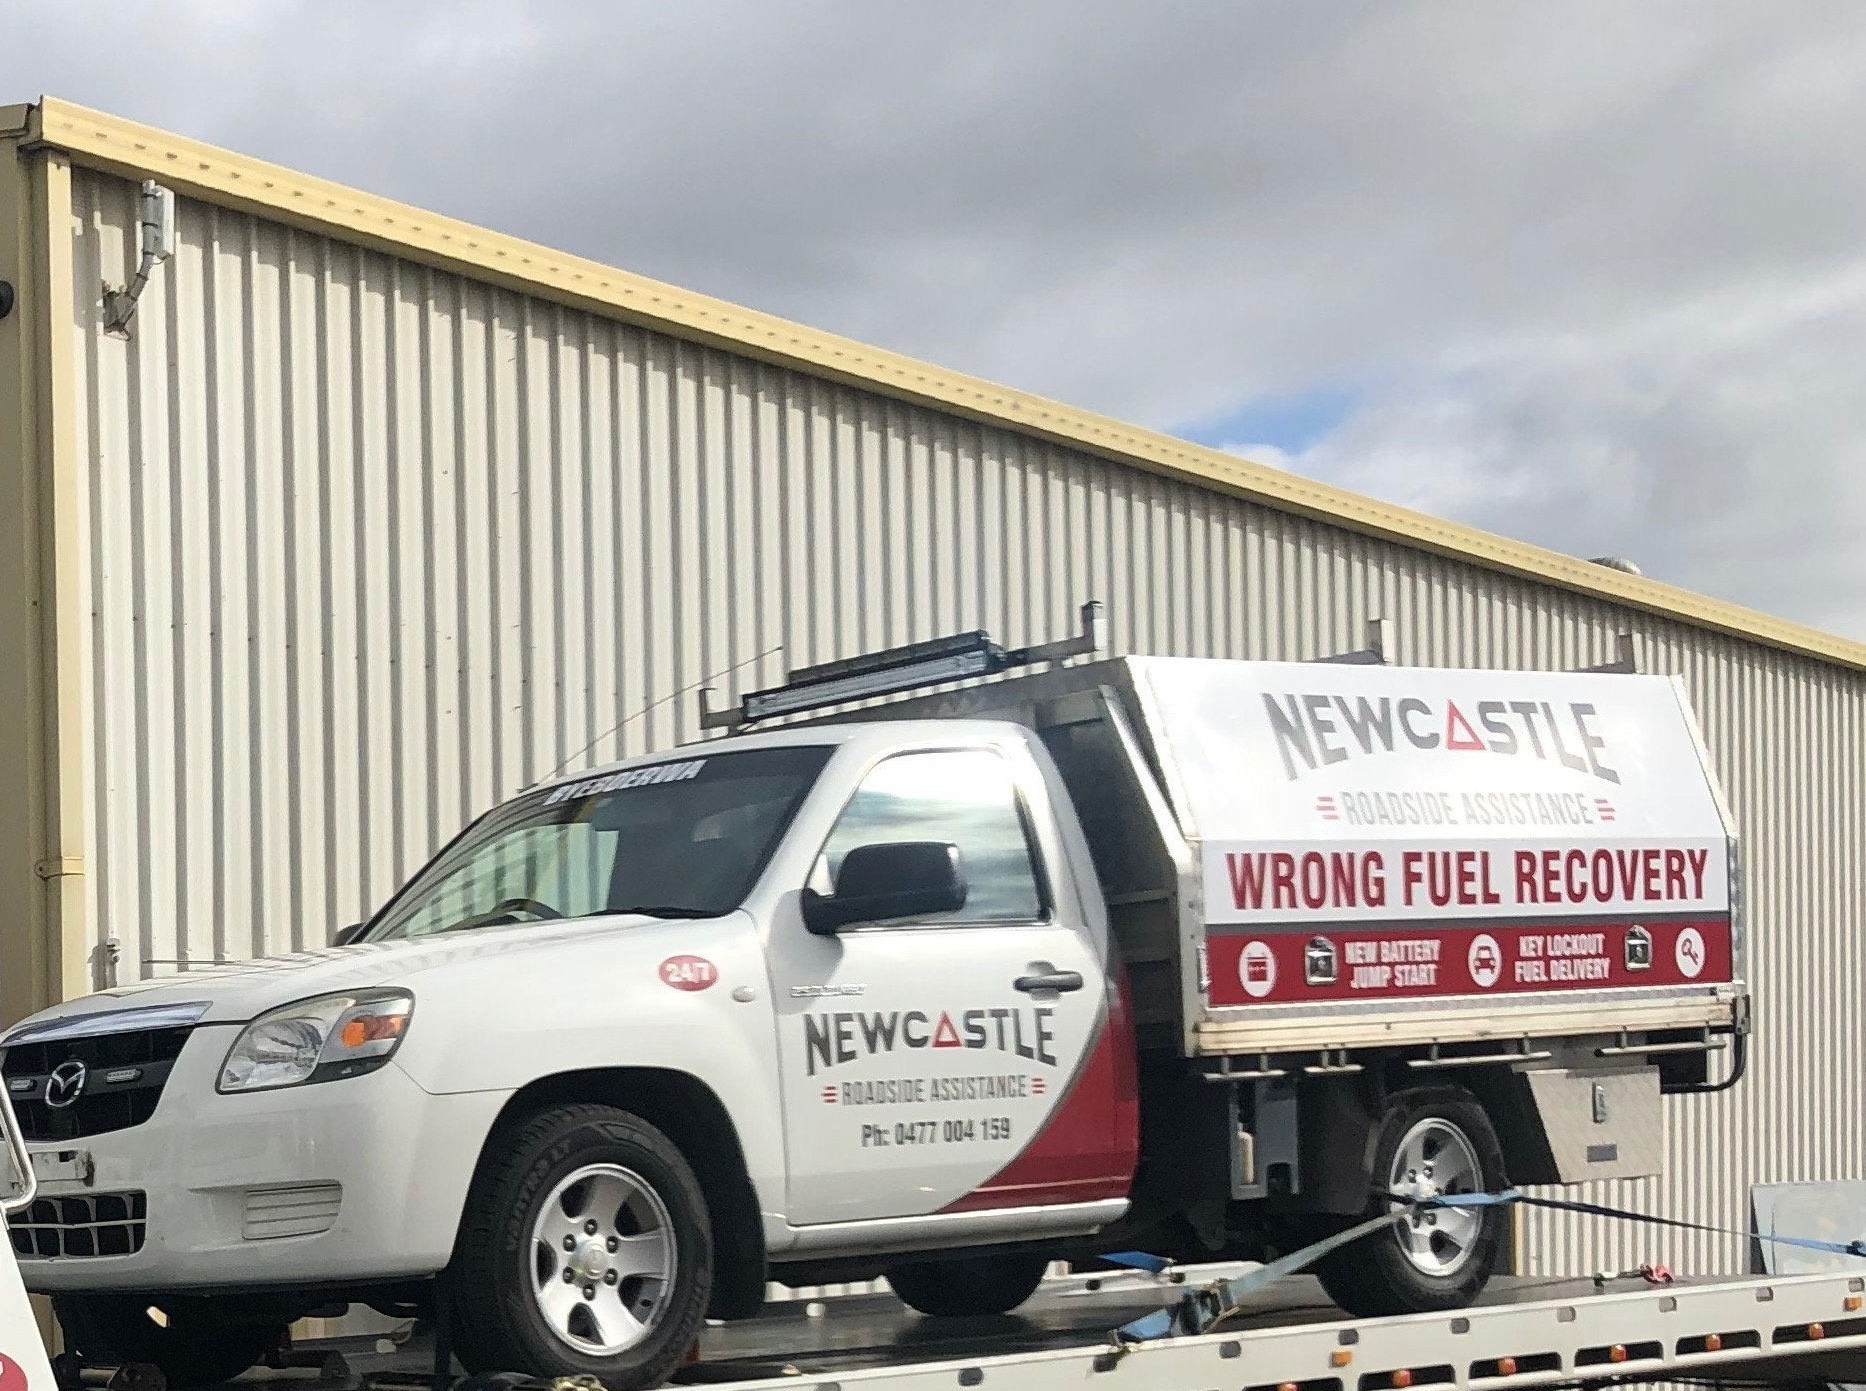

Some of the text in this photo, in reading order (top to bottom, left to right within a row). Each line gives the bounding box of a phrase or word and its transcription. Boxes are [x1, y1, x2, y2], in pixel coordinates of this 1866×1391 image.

[1261, 692, 1622, 785] NEWCASTLE
[1340, 791, 1596, 826] ROADSIDE ASSISTANCE
[1226, 848, 1710, 911] WRONG FUEL RECOVERY
[1344, 939, 1441, 964] NEW BATTERY
[1519, 933, 1605, 957] KEY LOCKOUT
[666, 963, 710, 983] 24/7
[1350, 963, 1438, 989] JUMP START
[1514, 958, 1611, 983] FUEL DELIVERY
[803, 1007, 1057, 1076] NEWCASTLE
[841, 1074, 1028, 1106] ROADSIDE ASSISTANCE
[861, 1116, 1011, 1148] Ph: 0477 004 159
